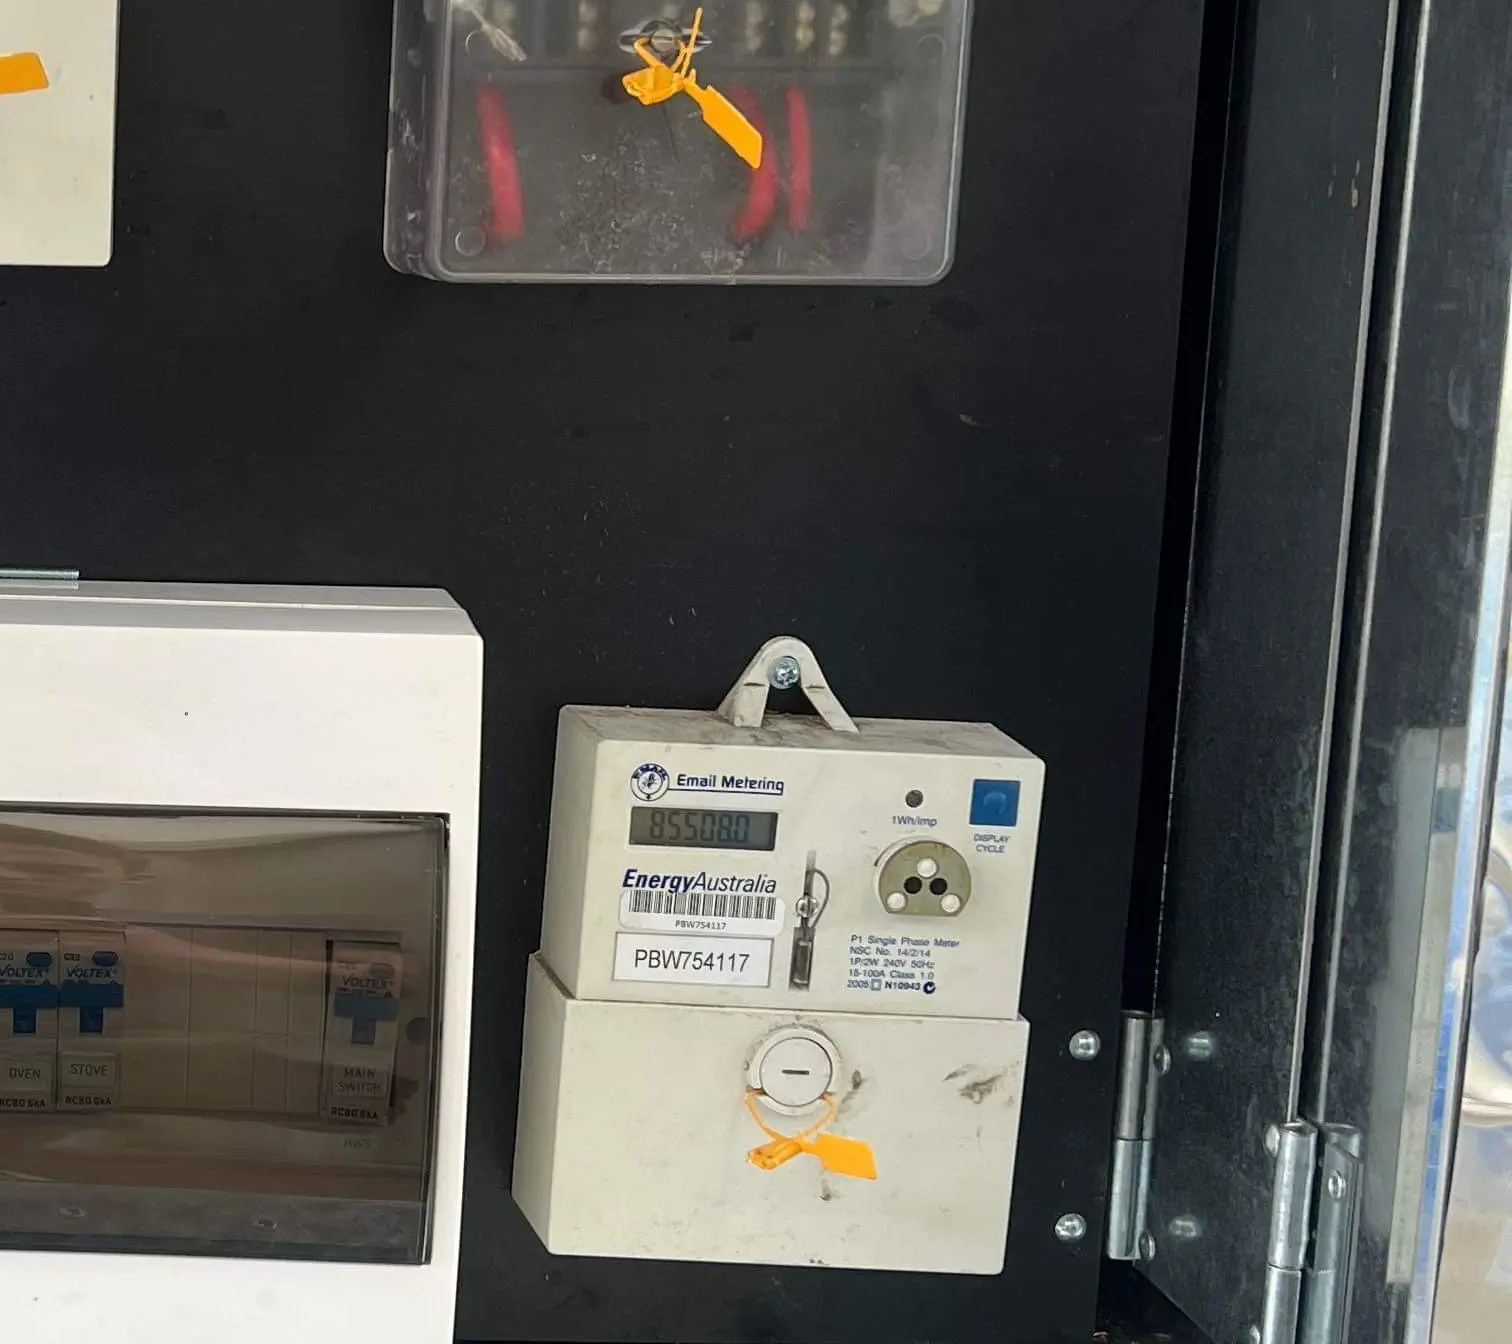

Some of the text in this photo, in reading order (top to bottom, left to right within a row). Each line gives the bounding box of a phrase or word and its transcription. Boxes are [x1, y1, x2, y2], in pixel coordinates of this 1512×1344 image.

[676, 774, 784, 794] Email Metering
[974, 833, 1010, 842] DISPLAY
[976, 844, 1006, 853] CYCLE
[622, 868, 777, 894] EnergyAustralia
[674, 920, 727, 930] PBW754117
[868, 935, 896, 947] Single
[900, 936, 930, 946] Phase
[849, 946, 872, 956] NSC
[634, 948, 750, 972] PBW754117
[890, 970, 916, 978] Class
[8, 1067, 41, 1080] OVEN
[70, 1064, 108, 1076] STOVE
[344, 1067, 376, 1078] MAIN
[336, 1082, 381, 1092] SWITCH
